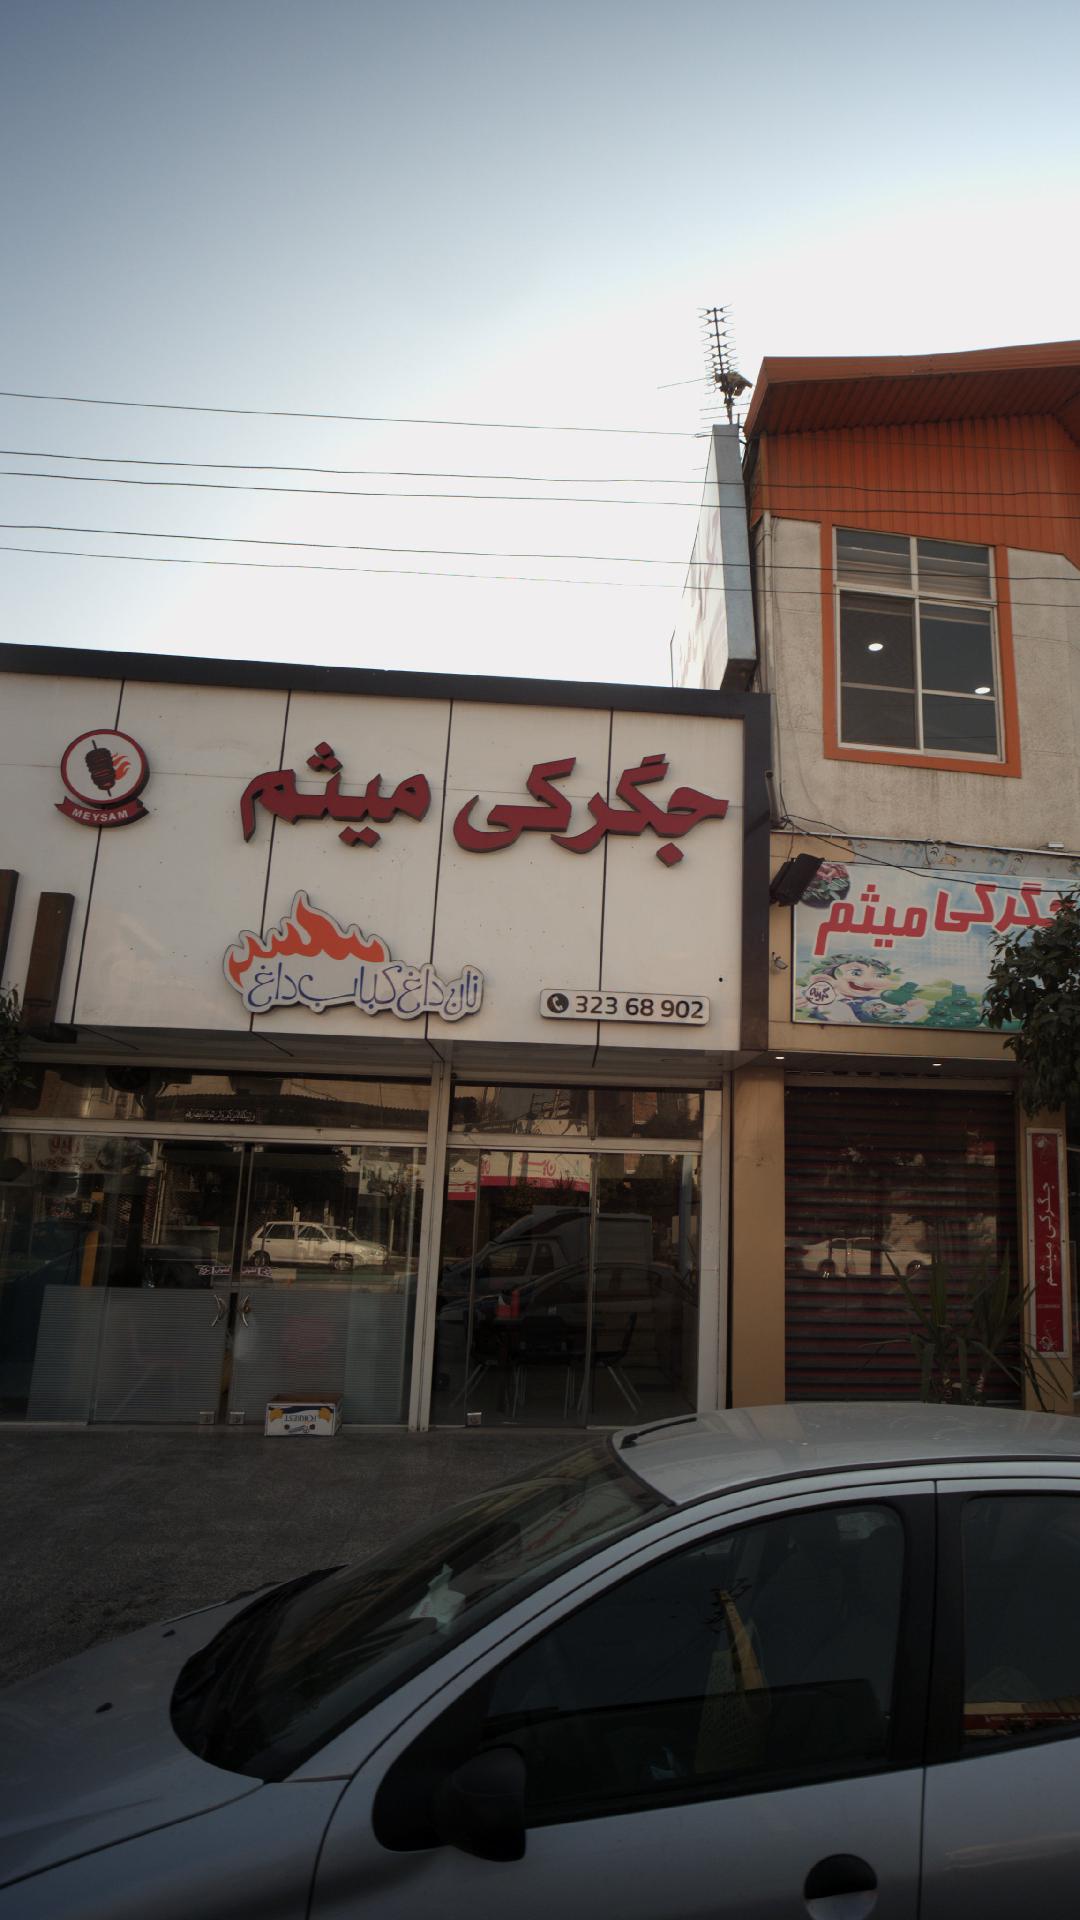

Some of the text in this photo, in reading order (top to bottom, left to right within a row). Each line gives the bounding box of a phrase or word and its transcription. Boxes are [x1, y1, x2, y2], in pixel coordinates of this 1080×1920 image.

[71, 808, 129, 822] MEYSAM
[240, 741, 730, 867] جگرکی میثم
[813, 884, 928, 956] میثم
[248, 962, 479, 1015] نان داغ کباب داغ
[575, 995, 704, 1019] 323 68 902
[1037, 1182, 1057, 1239] جگرکی
[1039, 1241, 1058, 1287] میثم
